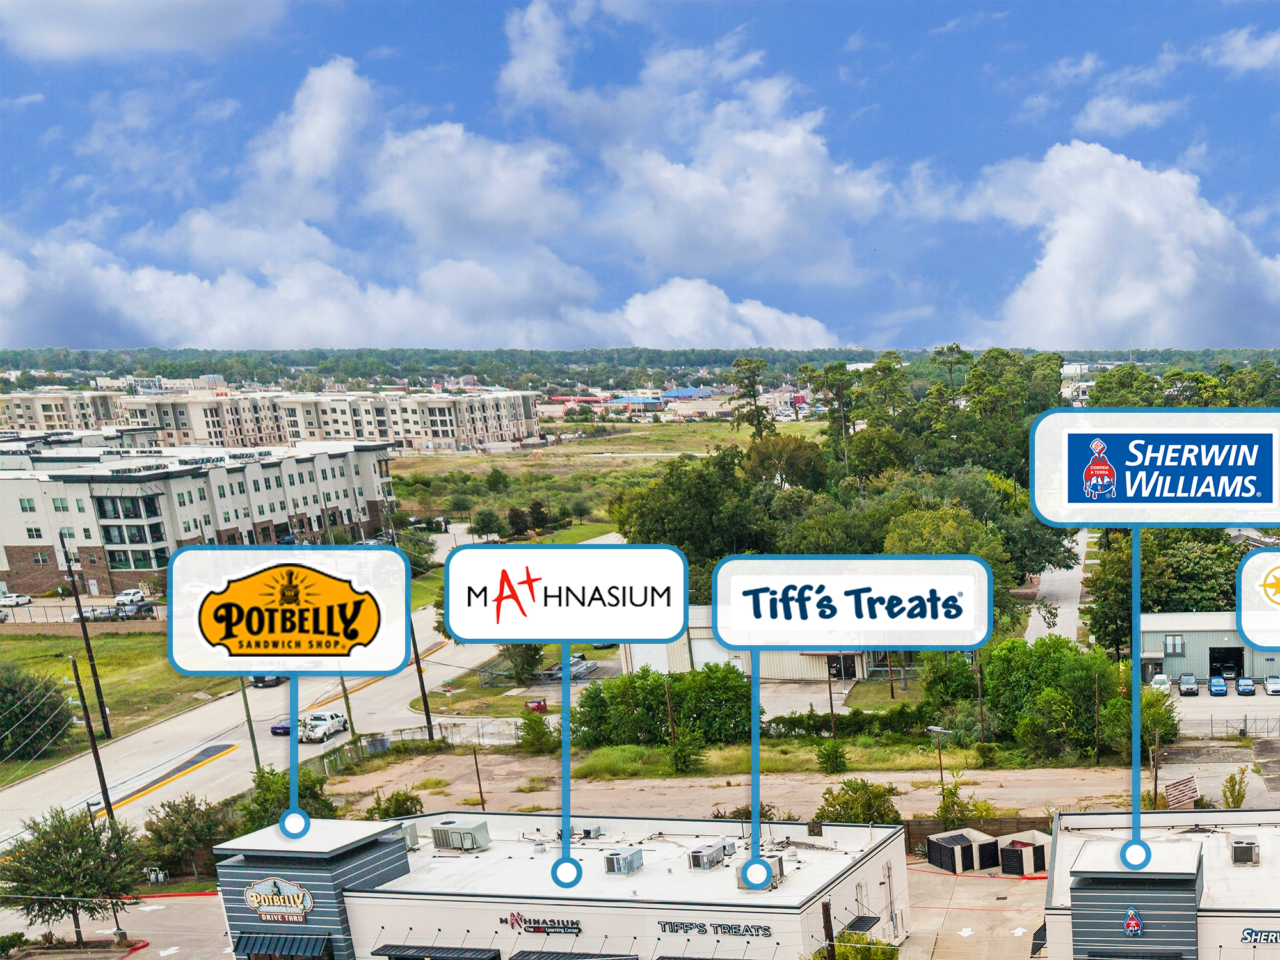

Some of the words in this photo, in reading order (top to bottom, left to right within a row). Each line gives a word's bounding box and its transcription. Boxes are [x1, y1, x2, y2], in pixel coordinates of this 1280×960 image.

[249, 891, 305, 910] POTBELLY
[285, 914, 303, 922] THRU
[658, 921, 707, 935] TIFF'S
[710, 923, 771, 937] TREATS
